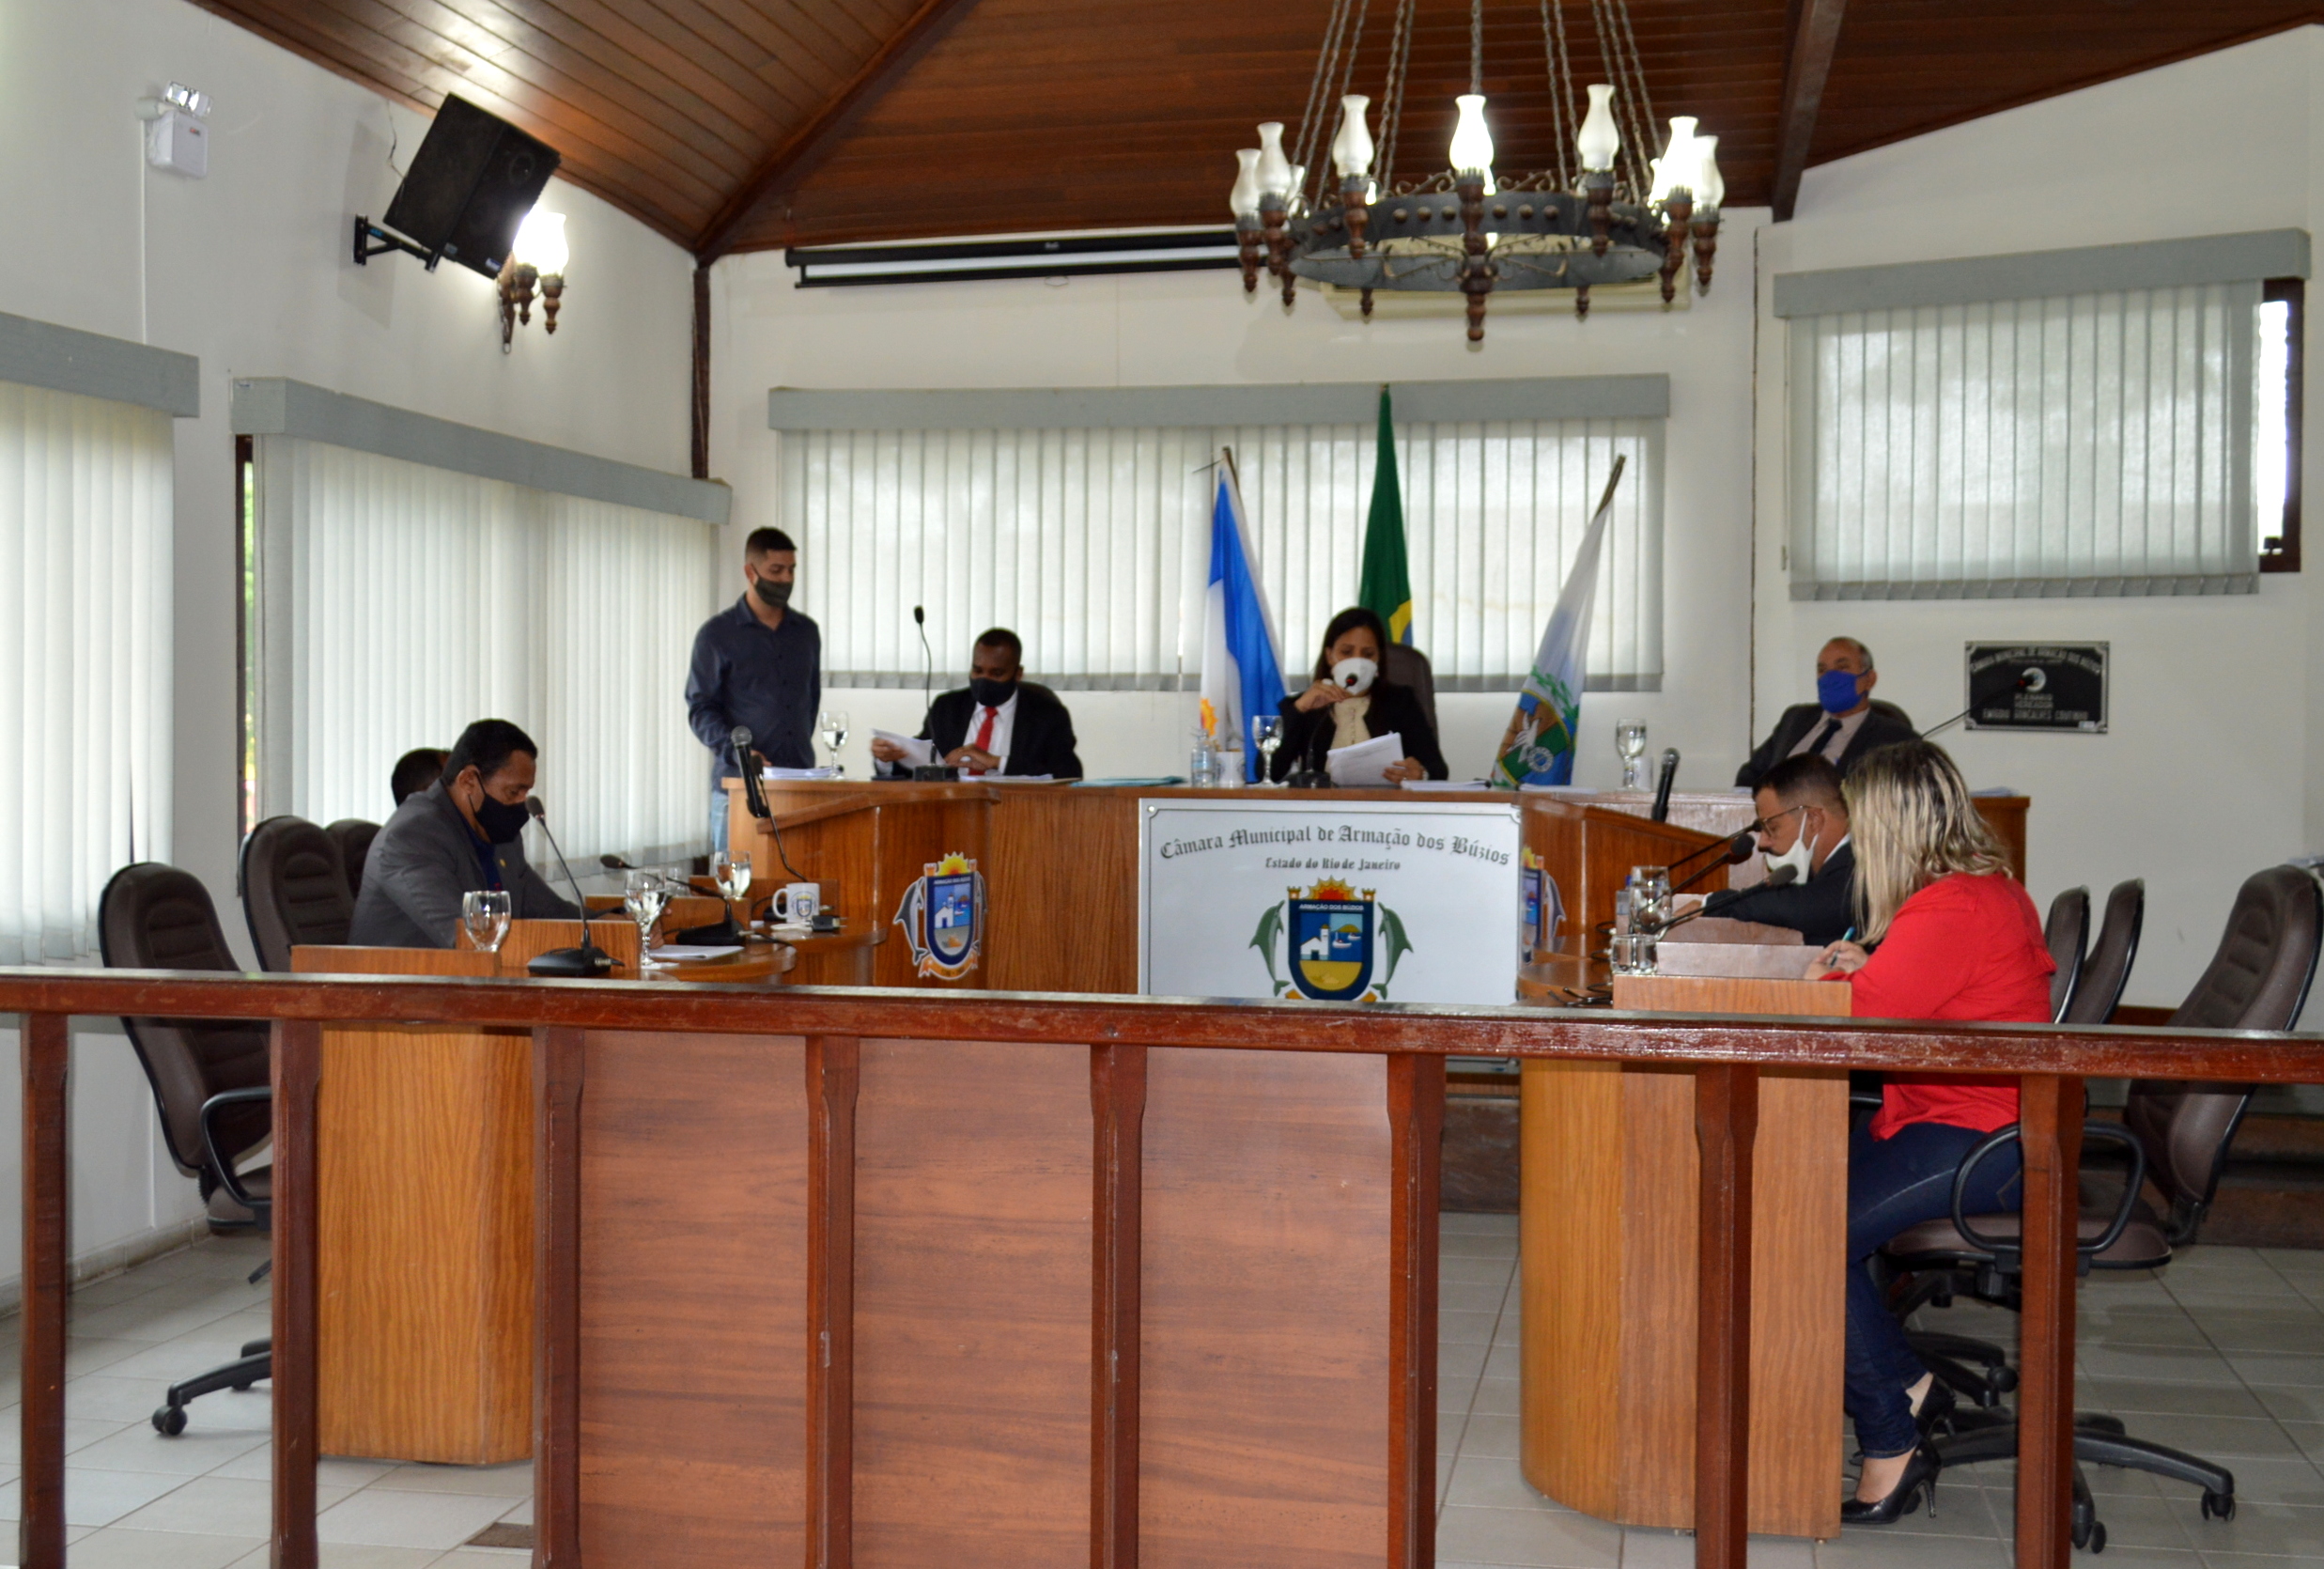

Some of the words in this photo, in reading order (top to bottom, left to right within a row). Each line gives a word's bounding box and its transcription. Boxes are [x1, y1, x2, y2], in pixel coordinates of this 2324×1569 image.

[1160, 836, 1223, 859] Câmara
[1229, 826, 1311, 848] Municipal
[1317, 826, 1335, 842] de
[1338, 825, 1411, 849] Armação
[1417, 832, 1445, 850] dos
[1451, 835, 1511, 866] Búzios
[1265, 857, 1302, 869] Estado
[1305, 858, 1319, 869] do
[1322, 858, 1340, 870] Rio
[1341, 858, 1355, 870] de
[1357, 858, 1402, 871] Janeiro
